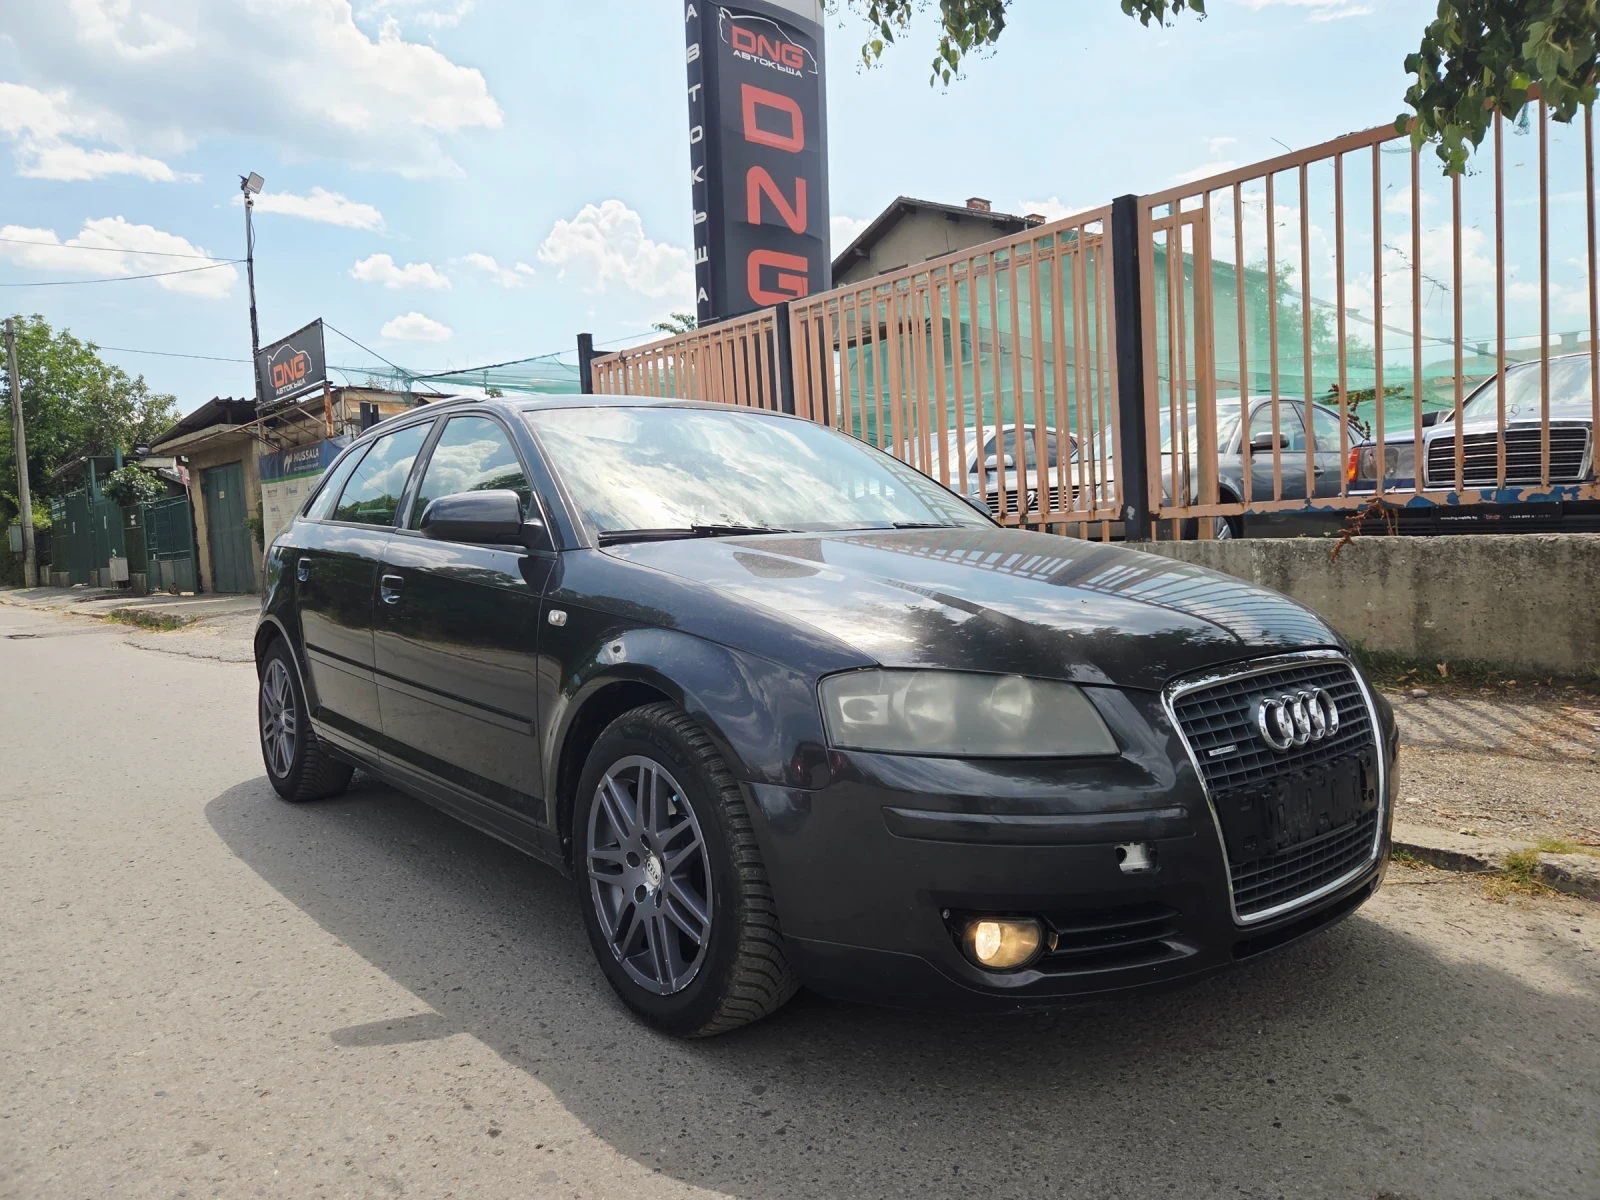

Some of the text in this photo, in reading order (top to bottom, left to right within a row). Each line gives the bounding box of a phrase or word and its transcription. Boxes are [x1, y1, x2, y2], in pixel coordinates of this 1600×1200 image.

[732, 25, 803, 69] DNG
[741, 83, 808, 307] DNG
[273, 353, 305, 388] DNG
